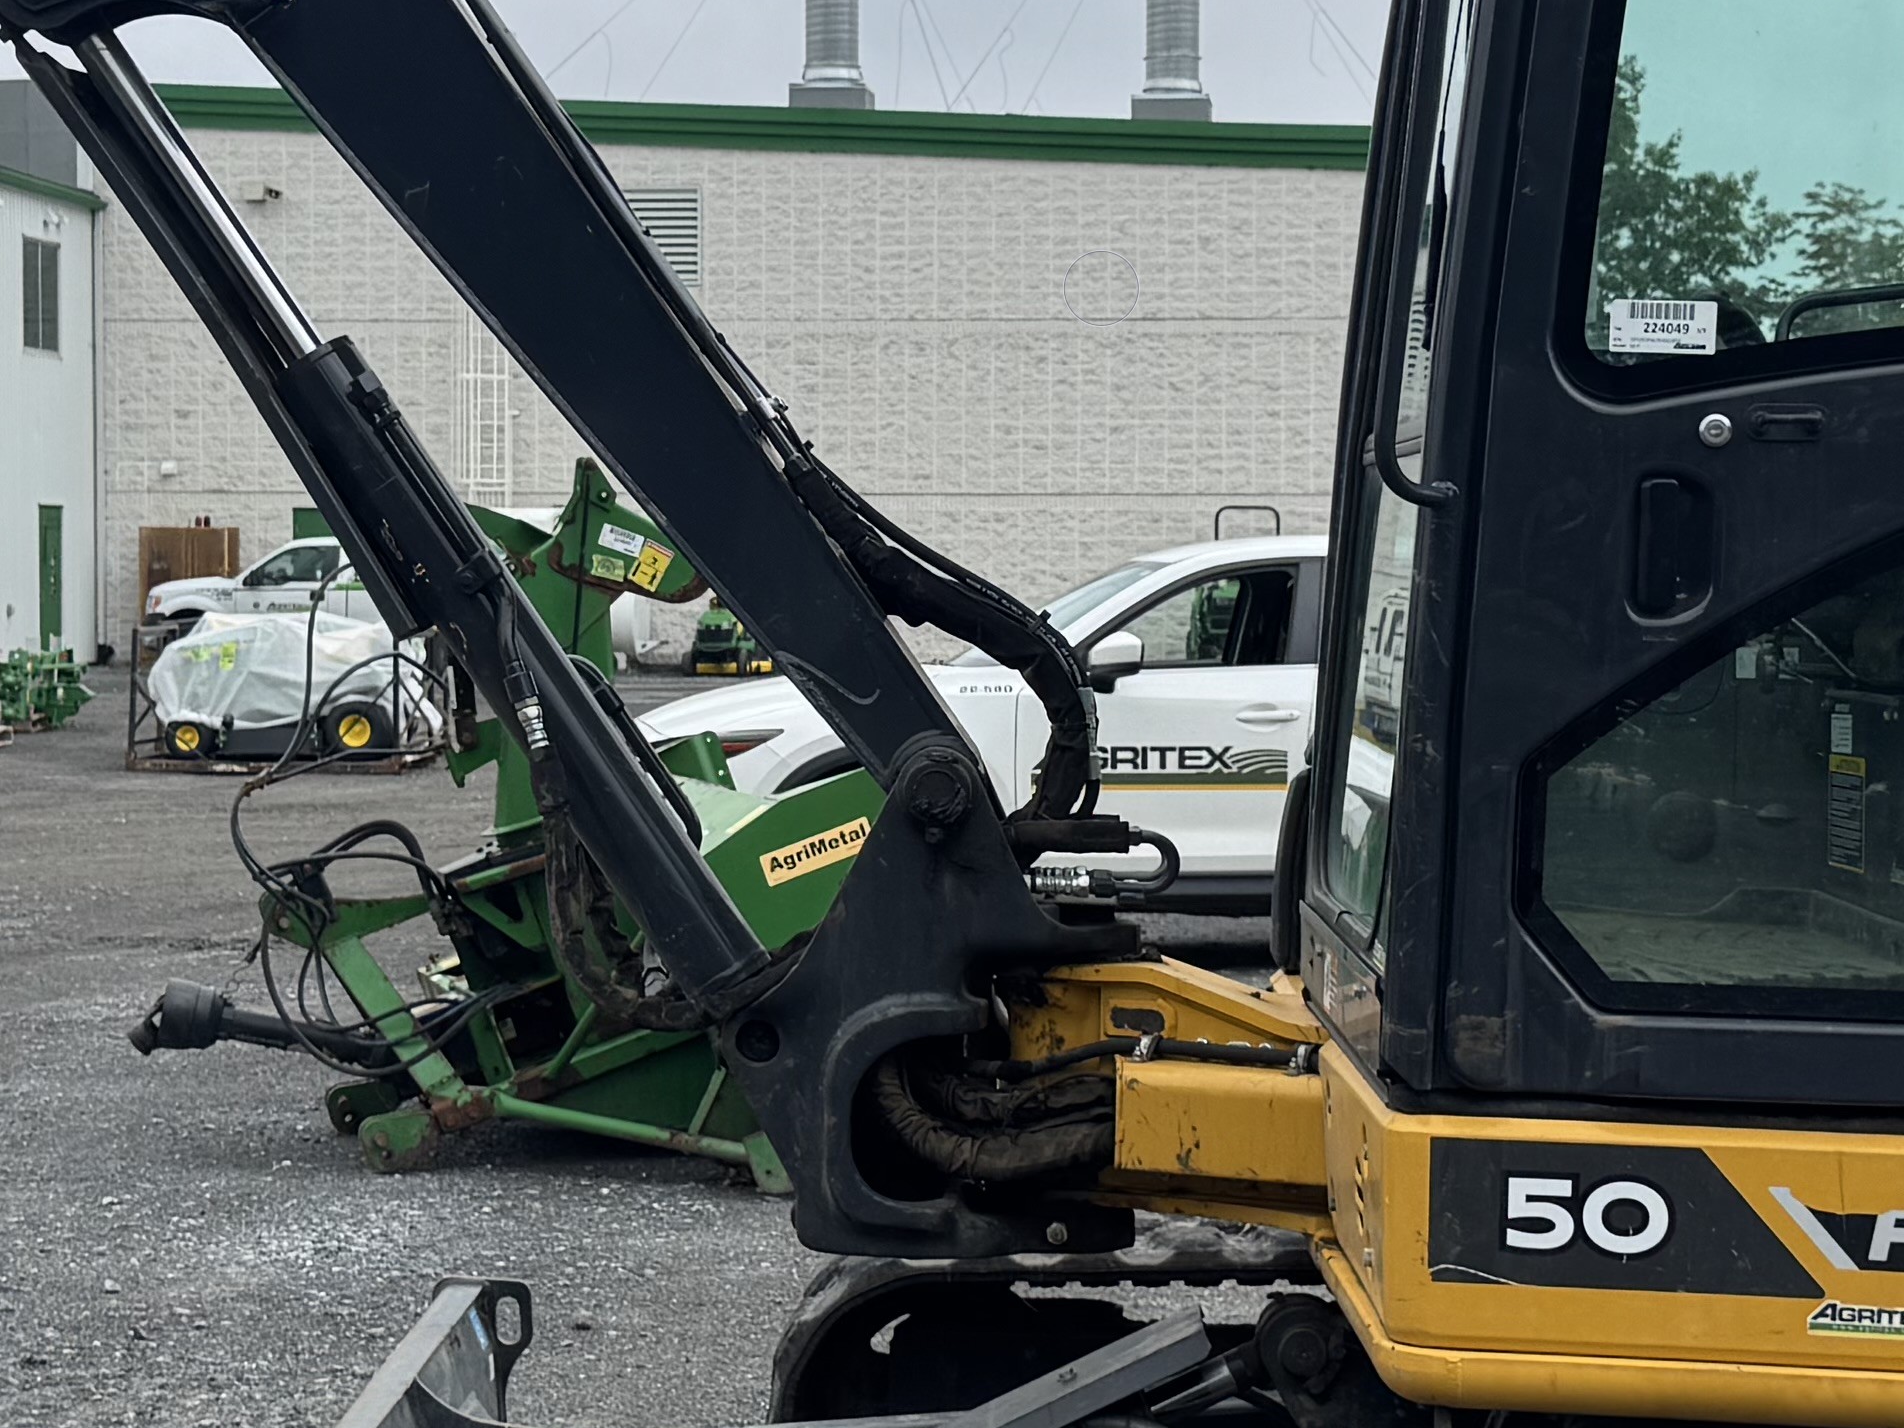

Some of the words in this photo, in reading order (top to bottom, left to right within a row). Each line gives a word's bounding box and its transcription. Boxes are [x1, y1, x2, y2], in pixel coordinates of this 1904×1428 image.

[1643, 322, 1690, 335] 224049
[1096, 745, 1234, 770] RITEX
[769, 822, 867, 873] AgriMetal
[1505, 1176, 1669, 1255] 50
